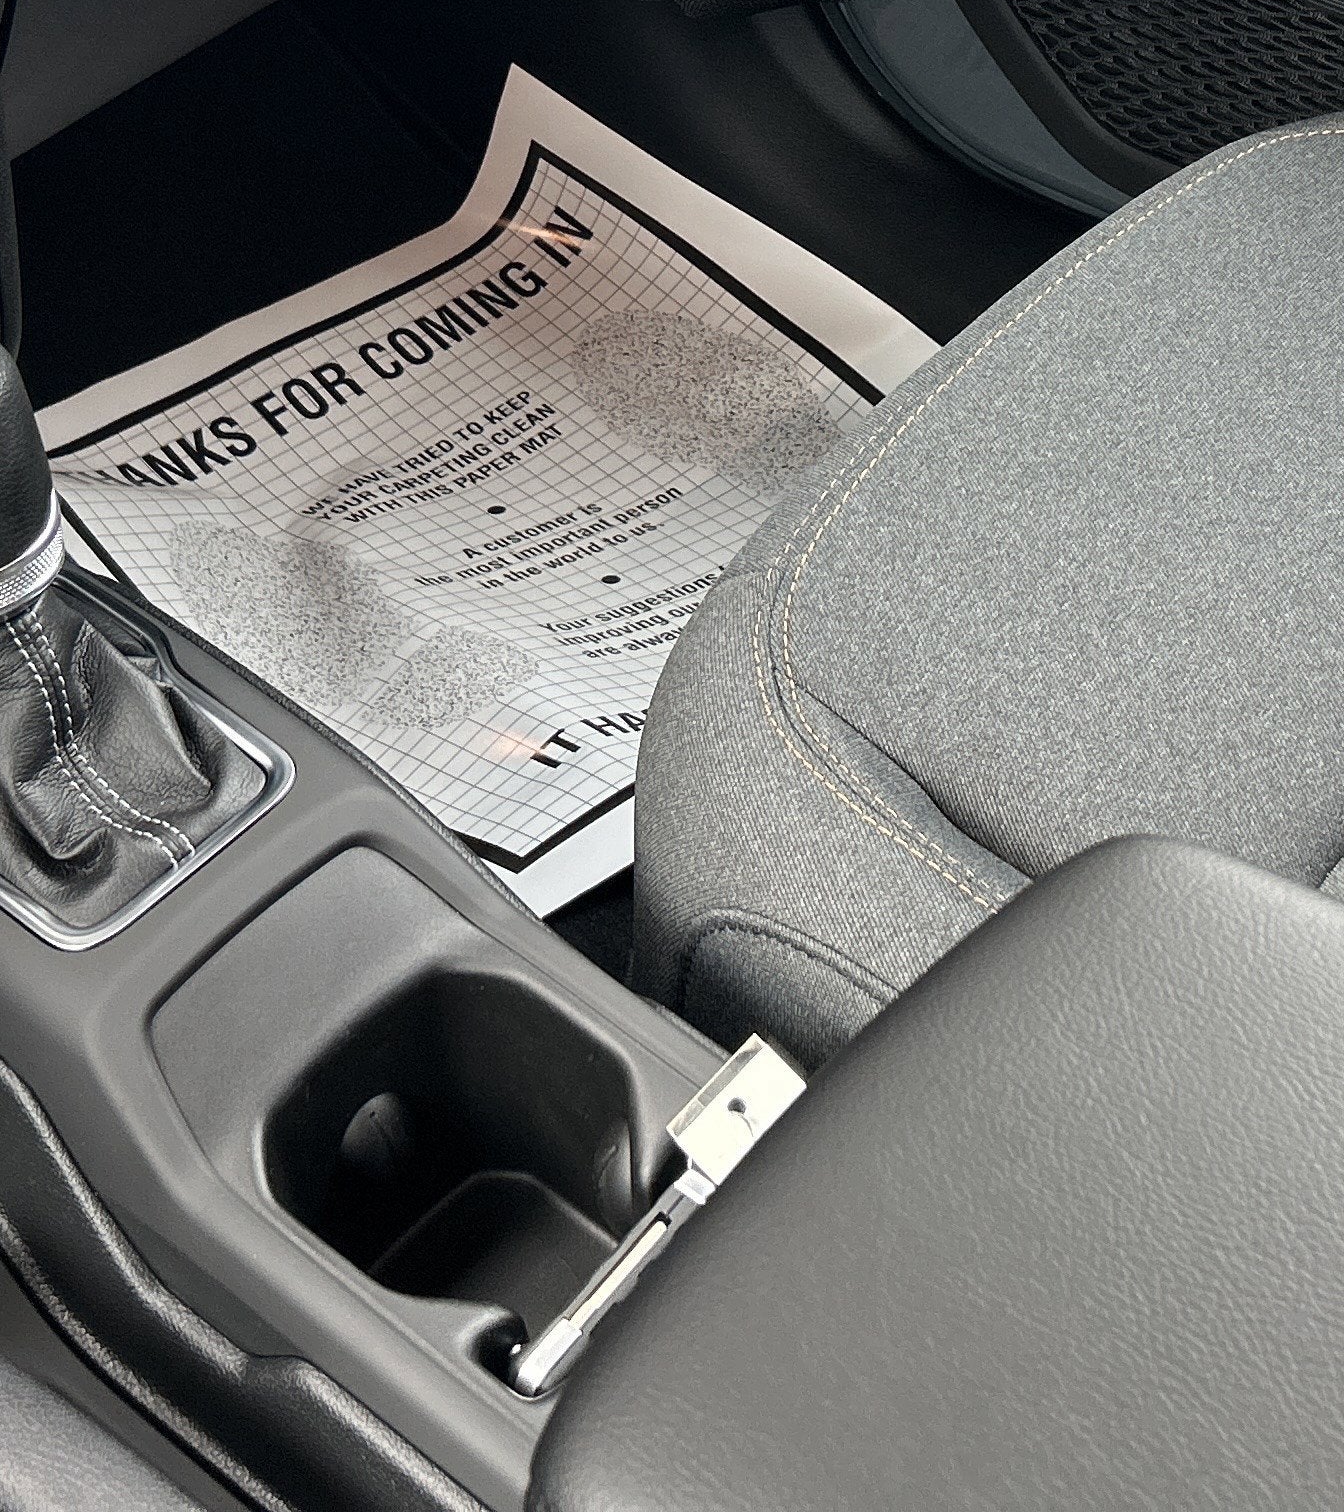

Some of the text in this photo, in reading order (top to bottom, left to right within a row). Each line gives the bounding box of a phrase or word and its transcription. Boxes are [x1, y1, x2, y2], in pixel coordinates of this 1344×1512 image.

[251, 359, 365, 438] FOR
[358, 259, 548, 381] COMING
[533, 204, 595, 268] IN
[302, 390, 531, 517] WE HAVE TRIED TO KEEP
[317, 403, 556, 522] YOUR CARPETING CLEAN
[344, 422, 564, 524] WITH THIS PAPER MAT
[415, 485, 684, 588] the most important person
[462, 502, 603, 559] A customer is
[478, 520, 666, 591] in the world to us.
[538, 572, 719, 634] Your suggestions
[557, 612, 670, 647] improving
[582, 644, 622, 659] are
[529, 708, 648, 769] IT HA
